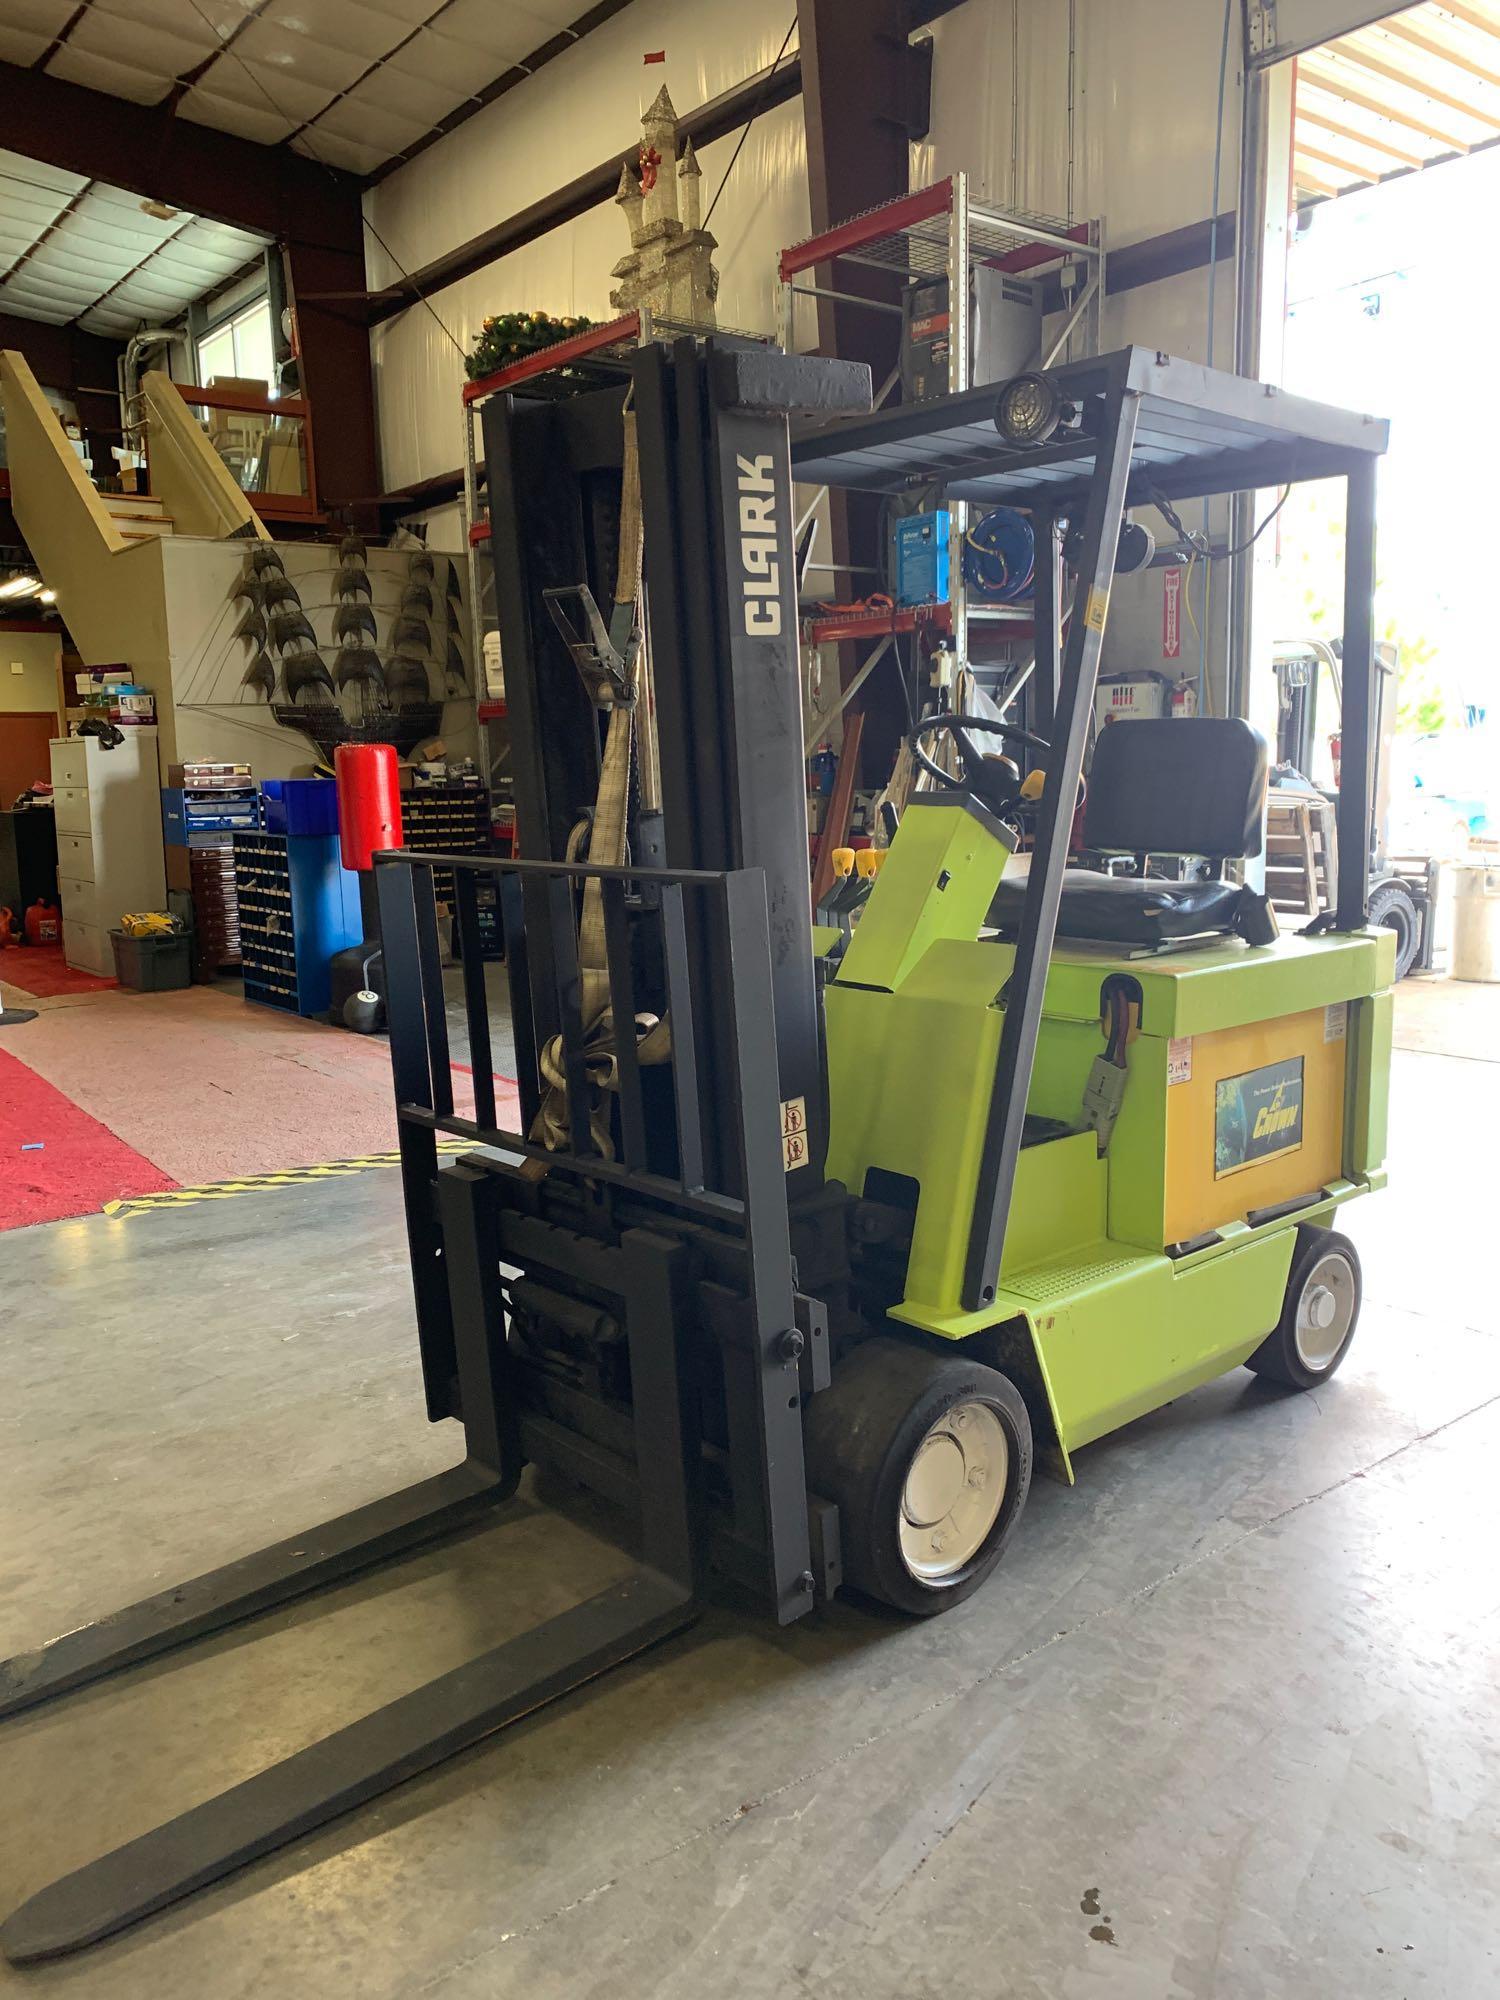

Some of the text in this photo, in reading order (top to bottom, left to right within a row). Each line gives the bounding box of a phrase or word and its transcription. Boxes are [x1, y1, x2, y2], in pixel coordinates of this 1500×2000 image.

[912, 319, 931, 333] MAC
[736, 453, 782, 636] CLARK
[1166, 577, 1179, 586] FIRE
